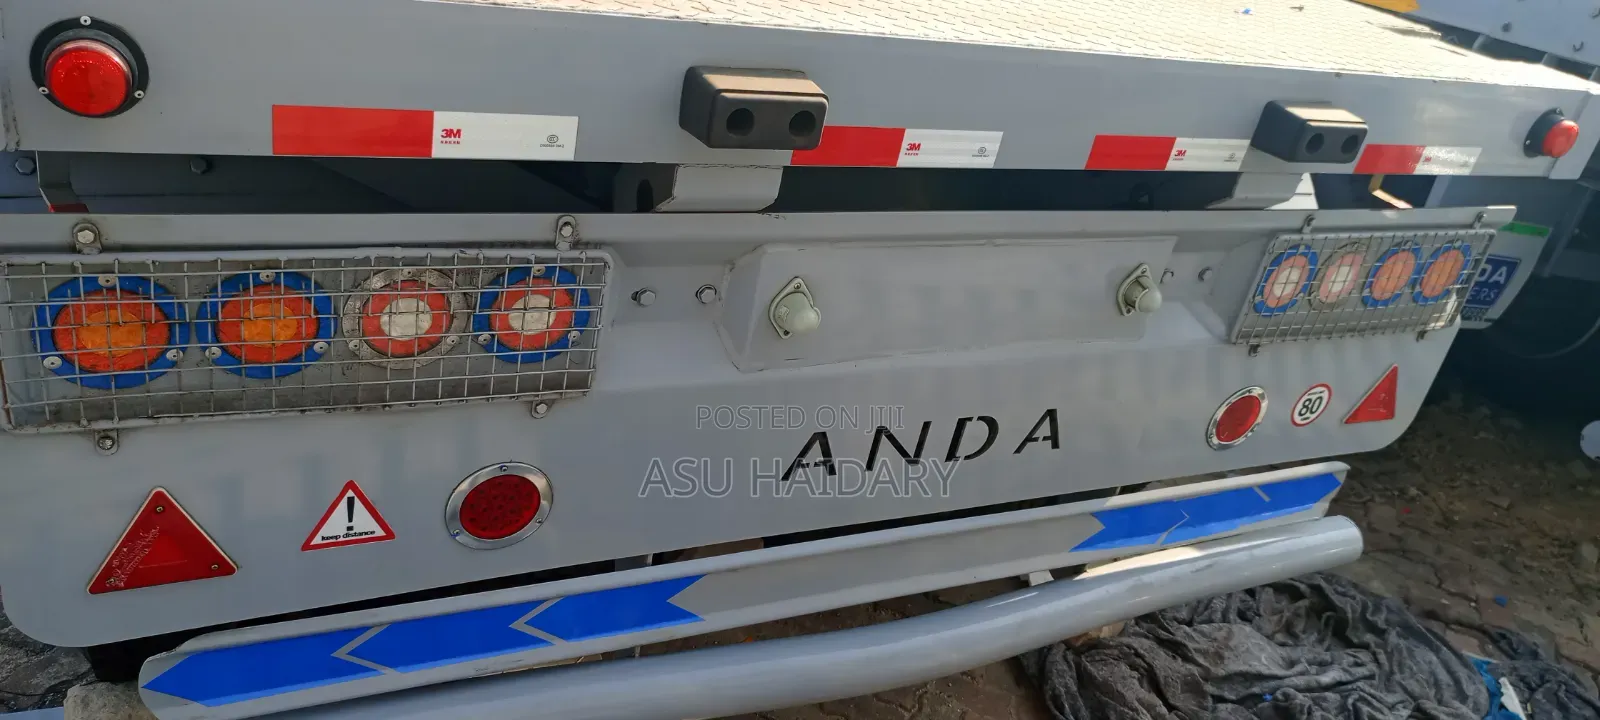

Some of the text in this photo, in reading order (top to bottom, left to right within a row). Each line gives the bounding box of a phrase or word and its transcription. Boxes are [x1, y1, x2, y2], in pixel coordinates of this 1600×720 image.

[441, 128, 461, 138] 3M
[906, 143, 921, 151] 3M
[1298, 396, 1324, 417] 80
[779, 408, 1061, 483] ANDA
[321, 530, 376, 542] keep distance
